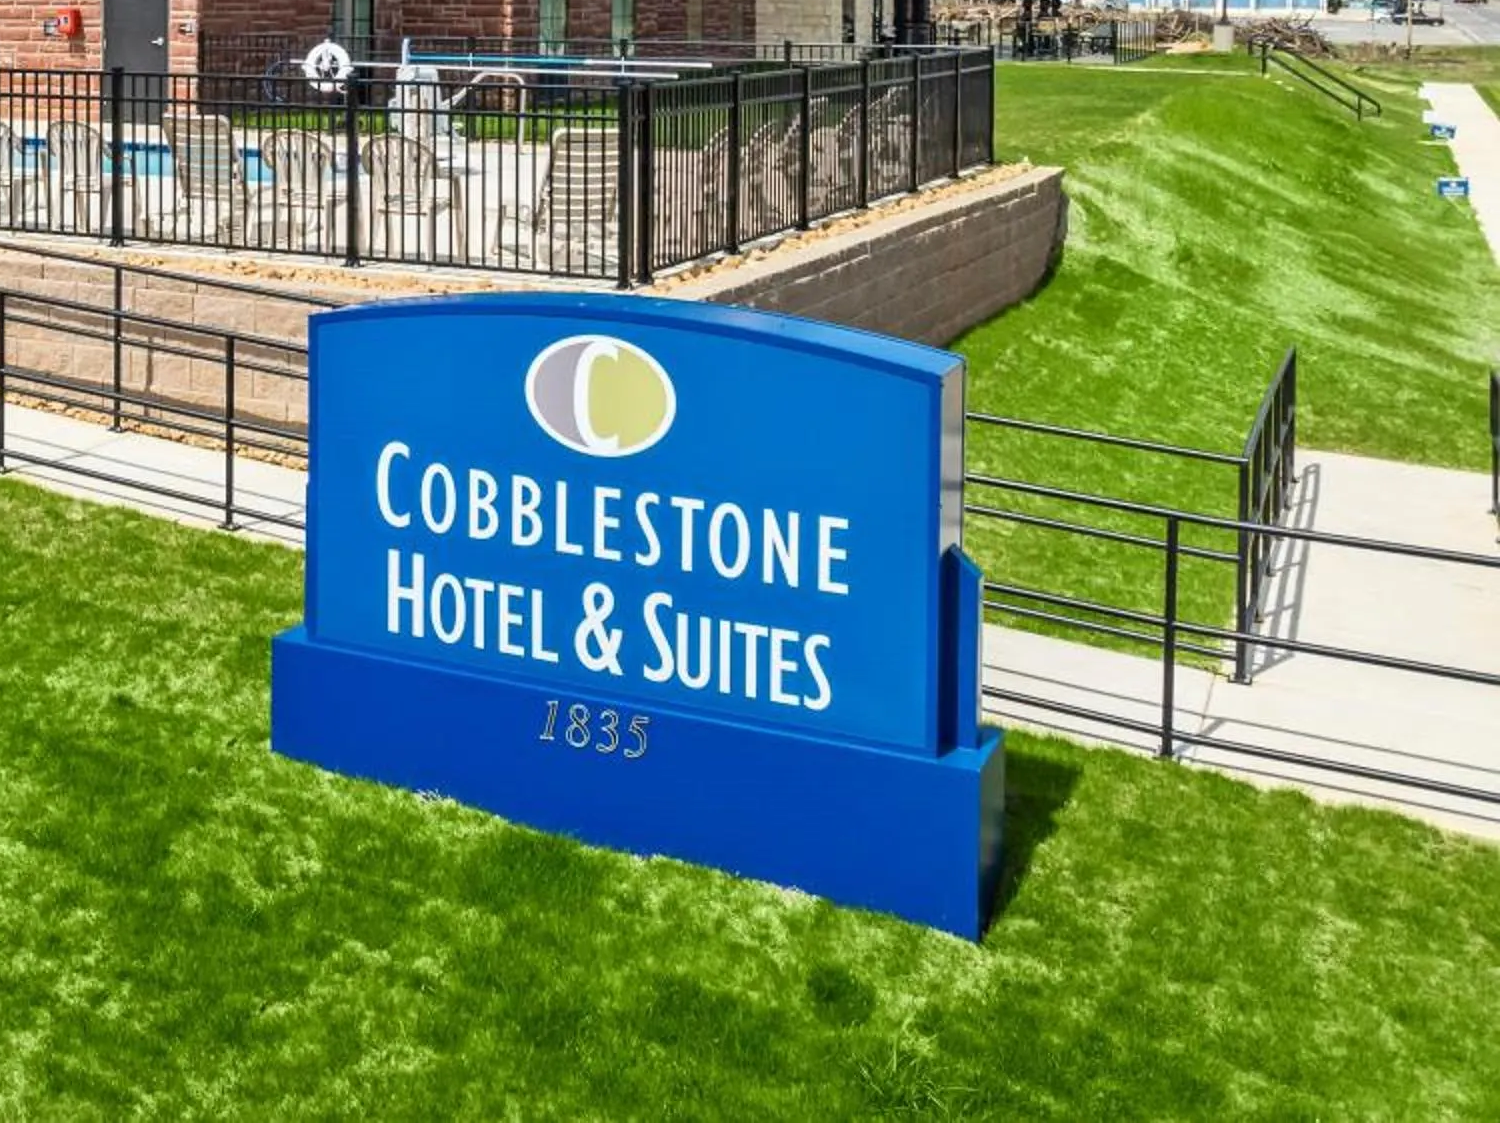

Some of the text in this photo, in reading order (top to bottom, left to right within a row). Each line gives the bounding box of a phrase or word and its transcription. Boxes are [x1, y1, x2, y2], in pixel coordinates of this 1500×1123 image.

[376, 441, 850, 595] COBBLESTONE
[387, 549, 832, 711] HOTEL & SUITES
[539, 700, 650, 758] 1835
